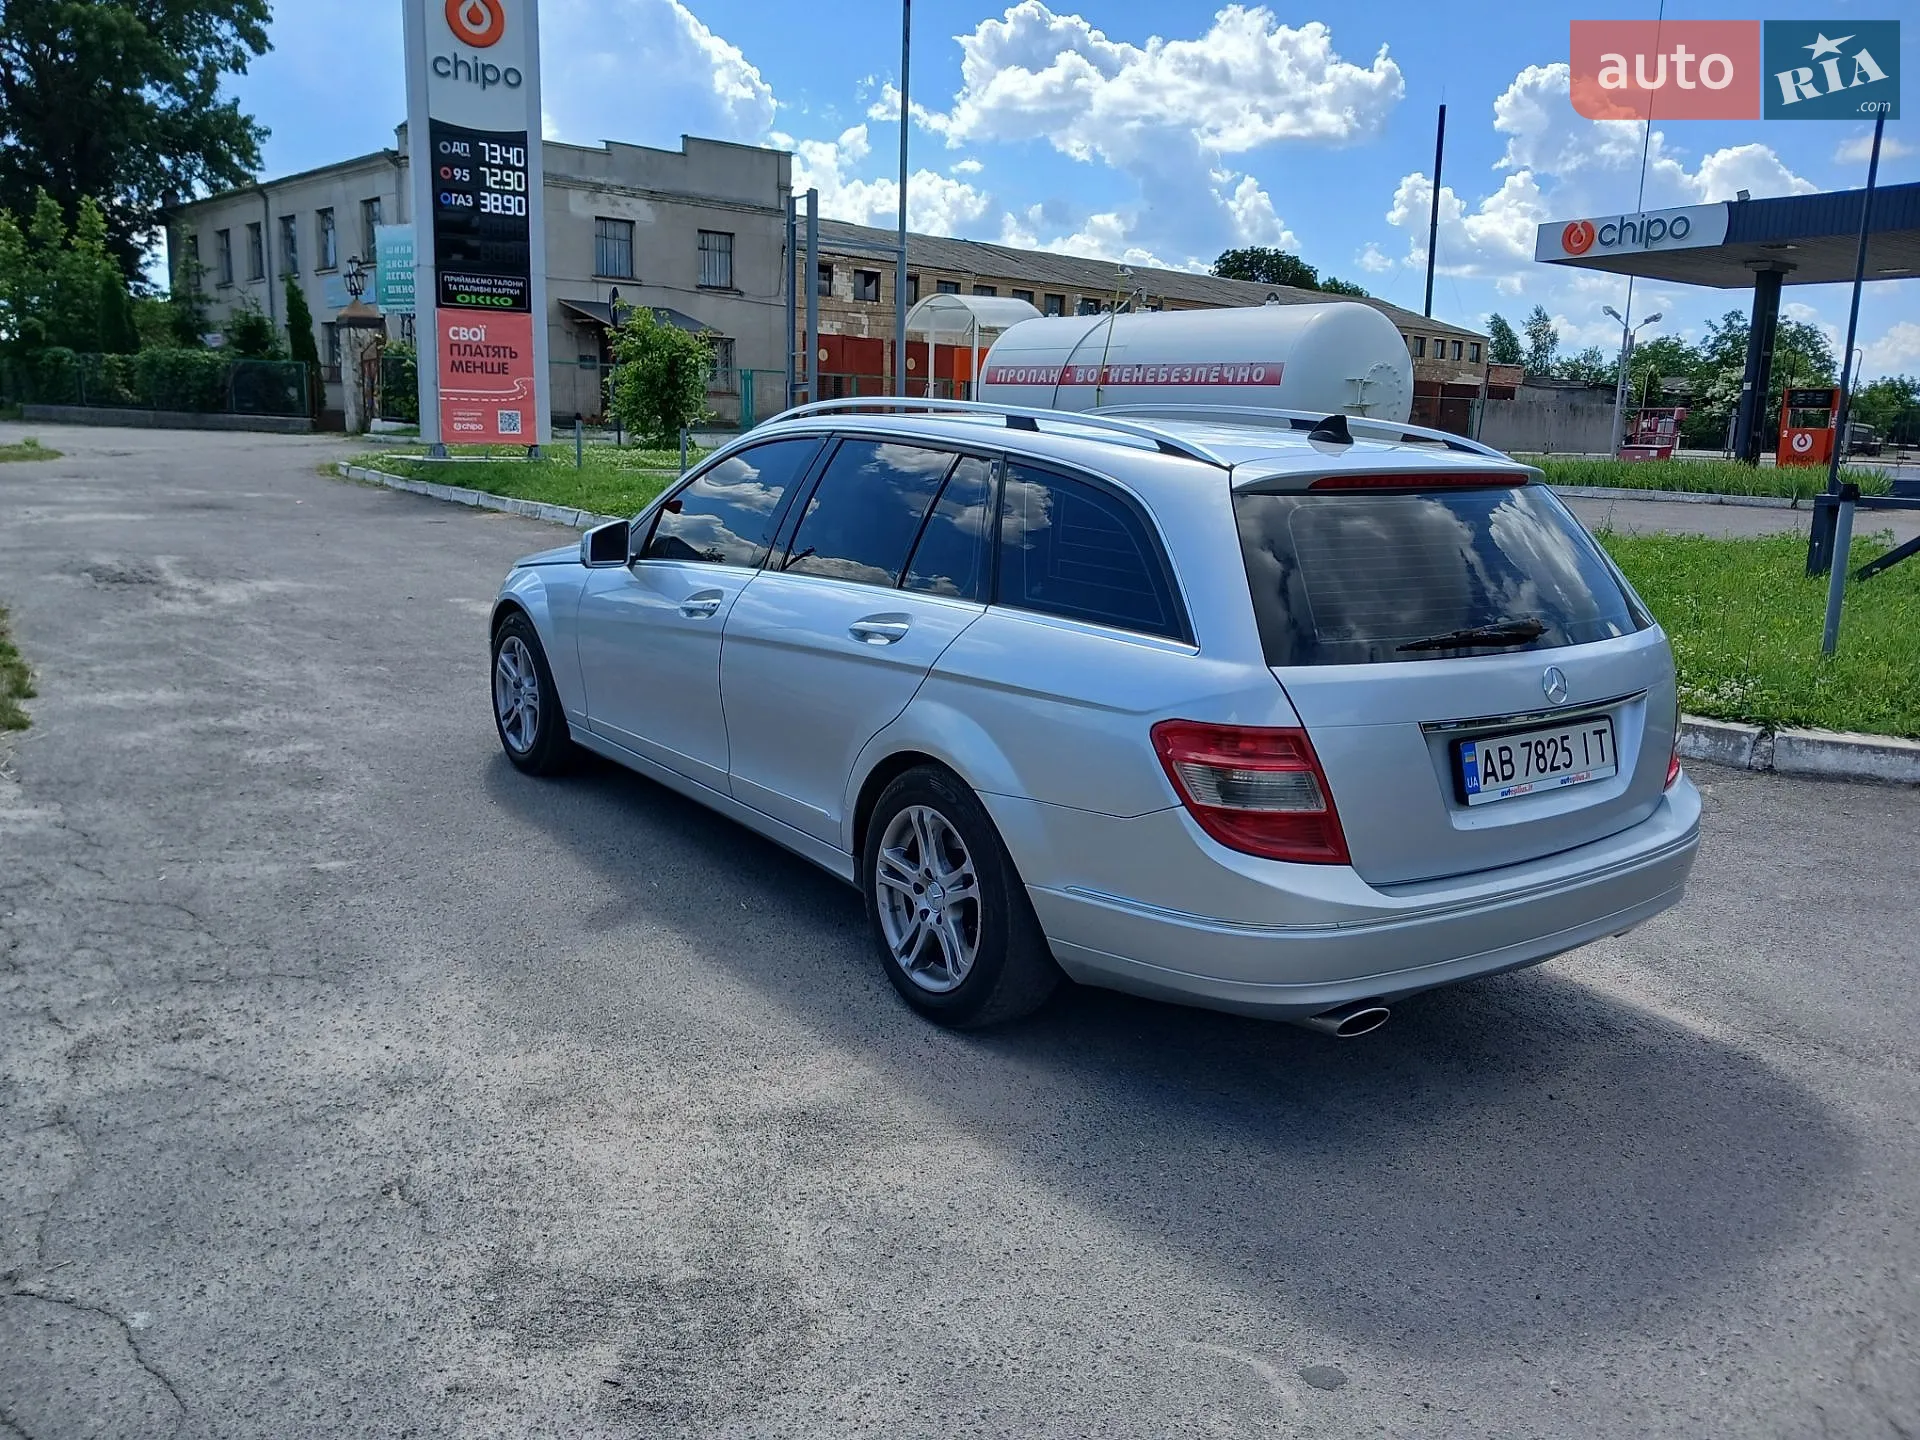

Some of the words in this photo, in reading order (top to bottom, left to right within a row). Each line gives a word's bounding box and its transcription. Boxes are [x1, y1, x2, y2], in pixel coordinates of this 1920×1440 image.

[432, 51, 522, 91] chipo
[479, 141, 525, 168] 73.40
[453, 167, 470, 182] 95
[479, 166, 526, 192] 72.90
[451, 192, 474, 207] ГАЗ
[480, 191, 526, 217] 38.90
[1598, 213, 1690, 249] chipo
[492, 287, 520, 296] КАРТКИ
[493, 279, 524, 288] ТАЛОНИ
[448, 324, 487, 342] СВОЇ
[449, 343, 519, 359] ПЛАТЯТЬ
[450, 360, 510, 375] МЕНШЕ
[996, 367, 1059, 383] ПРОПАН
[1482, 745, 1516, 786] AB
[1520, 735, 1573, 777] 7825
[1466, 777, 1479, 789] UA
